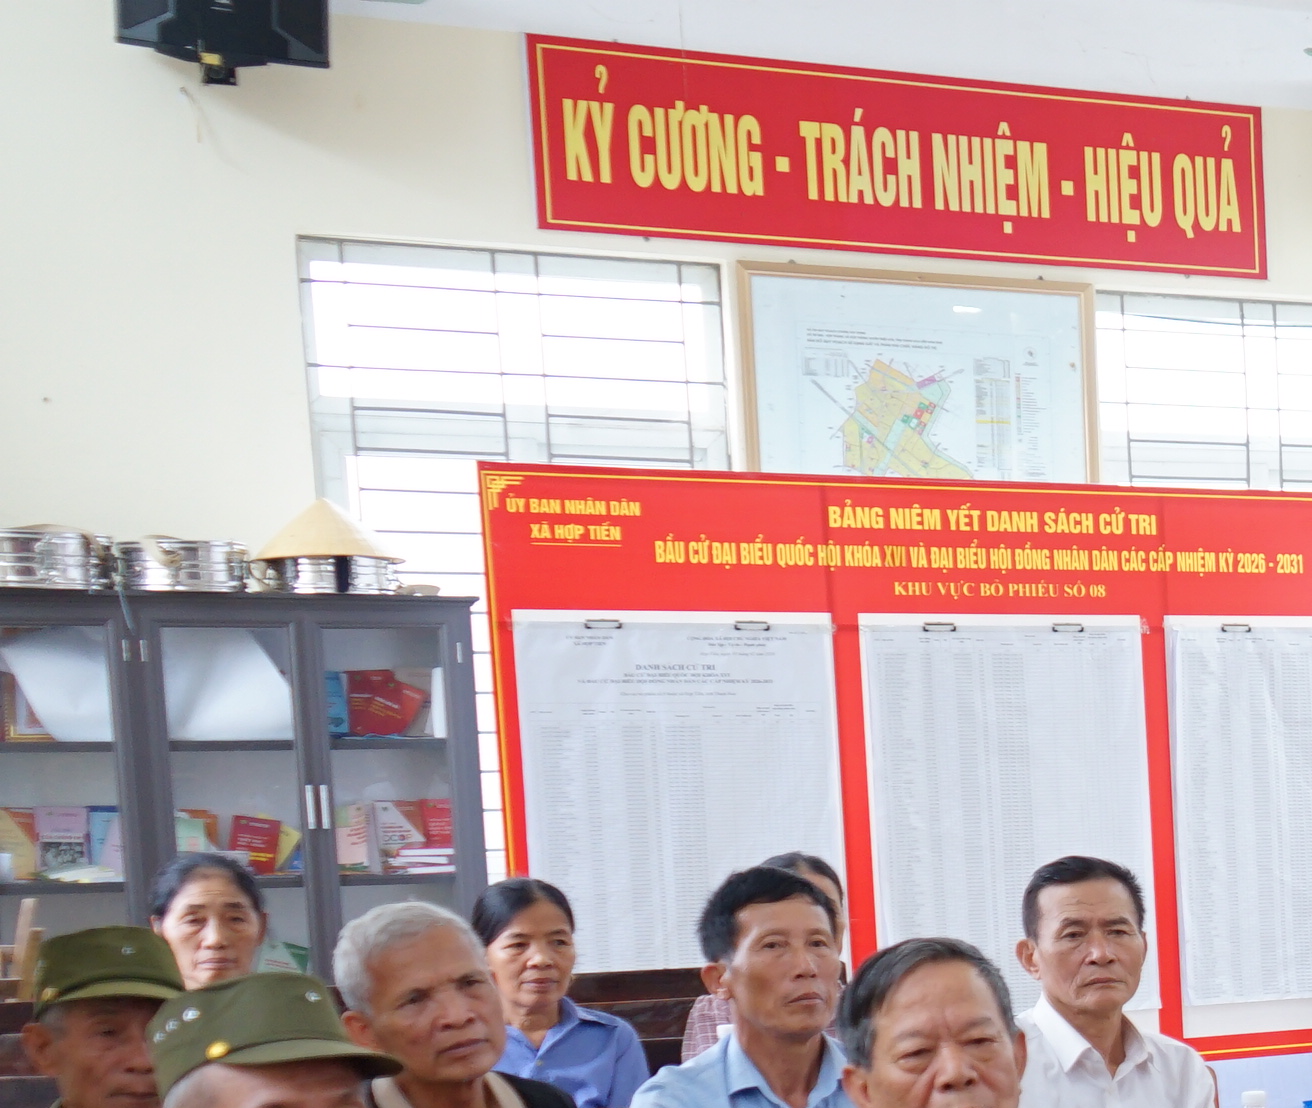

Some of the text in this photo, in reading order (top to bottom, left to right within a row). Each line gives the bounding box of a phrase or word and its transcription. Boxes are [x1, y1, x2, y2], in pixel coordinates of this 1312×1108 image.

[563, 65, 1240, 241] KỶ CƯƠNG - TRÁCH NHIỆM - HIỆU QUẢ
[529, 499, 562, 513] BAN
[564, 498, 608, 515] NHÂN
[609, 499, 641, 516] DÂN
[828, 500, 1157, 535] BẢNG NIÊM YẾT DANH SÁCH CỬ TRI
[530, 522, 621, 541] XÃ HỢP TIẾN
[654, 535, 686, 563] BẦU
[688, 535, 712, 564] CỬ
[710, 542, 738, 568] ĐẠI
[739, 535, 774, 565] BIỂU
[775, 539, 815, 567] QUỐC
[816, 541, 842, 570] HỘI
[845, 541, 882, 567] KHÓA
[884, 545, 906, 566] XVI
[909, 543, 929, 567] VÀ
[930, 547, 954, 572] ĐẠI
[956, 540, 987, 569] BIỂU
[989, 545, 1012, 573] HỘI
[1014, 543, 1051, 570] ĐỒNG
[1053, 546, 1090, 570] NHÂN
[1091, 547, 1119, 571] DÂN
[1121, 546, 1146, 571] CÁC
[1149, 543, 1173, 572] CẤP
[1176, 547, 1216, 577] NHIỆM
[1219, 548, 1234, 573] KỲ
[1237, 553, 1266, 573] 2026
[1277, 554, 1303, 573] 2031
[894, 582, 932, 597] KHU
[937, 580, 975, 600] VỰC
[1008, 580, 1059, 598] PHIẾU
[1064, 580, 1086, 598] SỐ
[1089, 584, 1106, 598] 08
